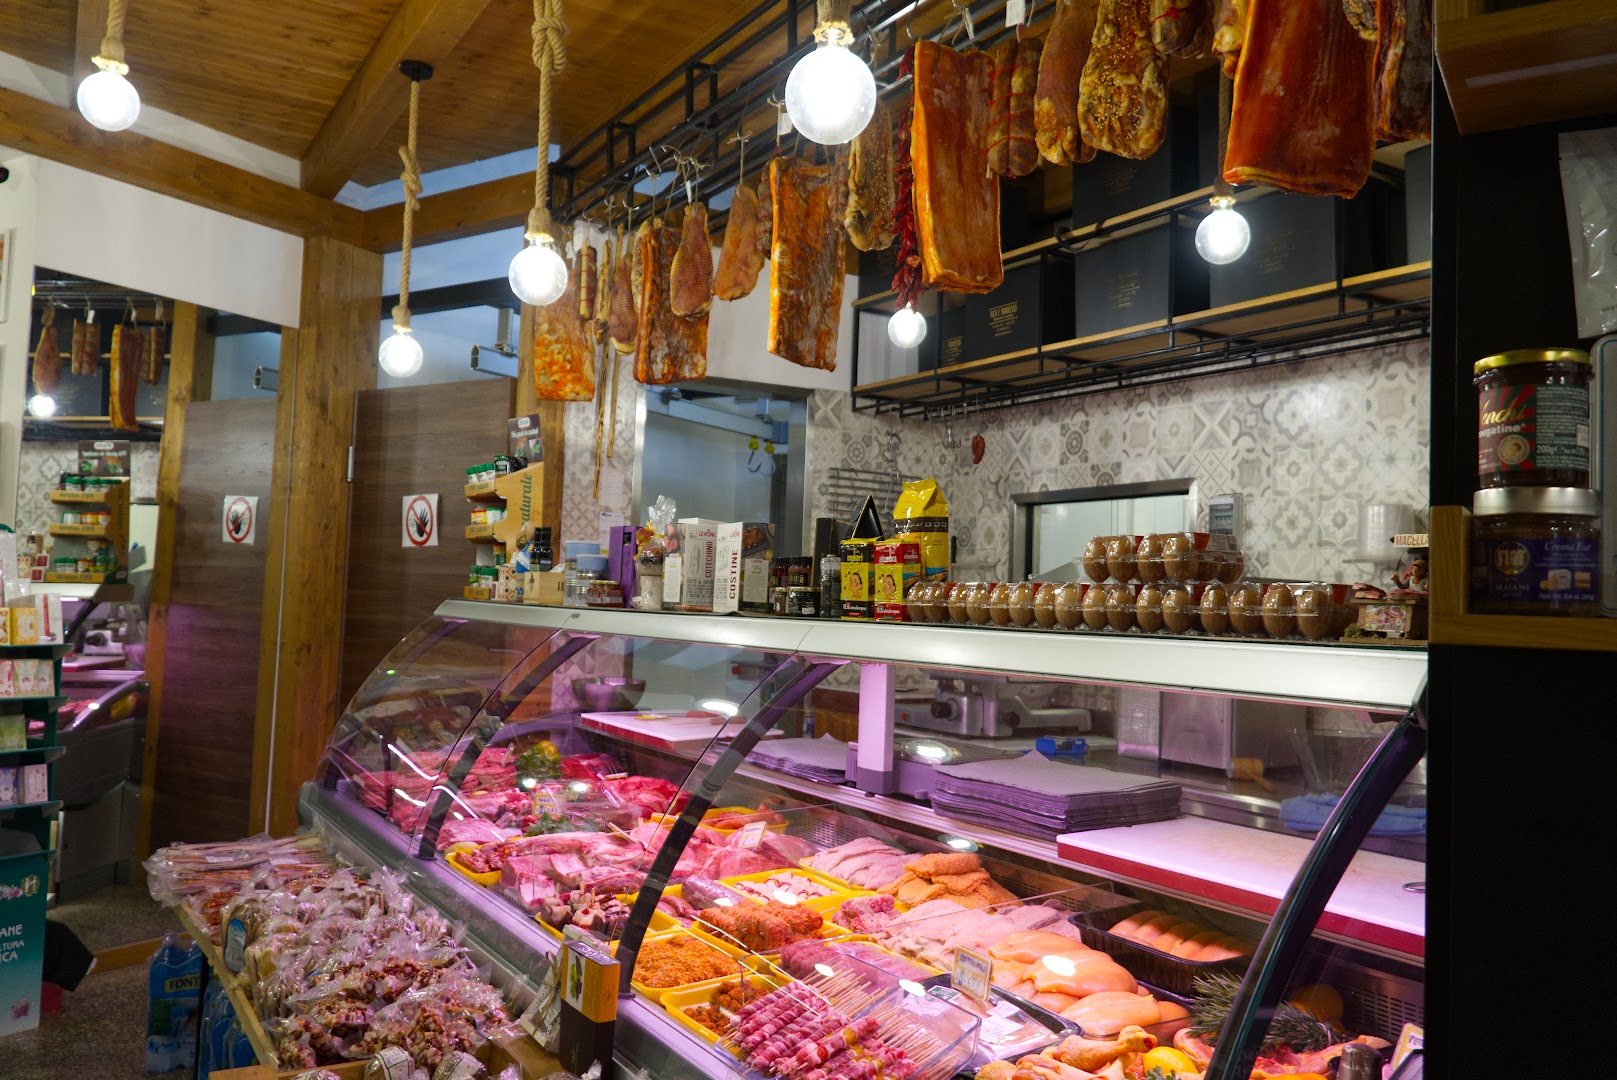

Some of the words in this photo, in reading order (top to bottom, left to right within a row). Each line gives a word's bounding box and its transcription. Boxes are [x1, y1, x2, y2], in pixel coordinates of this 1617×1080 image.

[705, 542, 714, 578] COTECHINO
[1544, 542, 1573, 551] Crema
[730, 549, 738, 600] COSTINE
